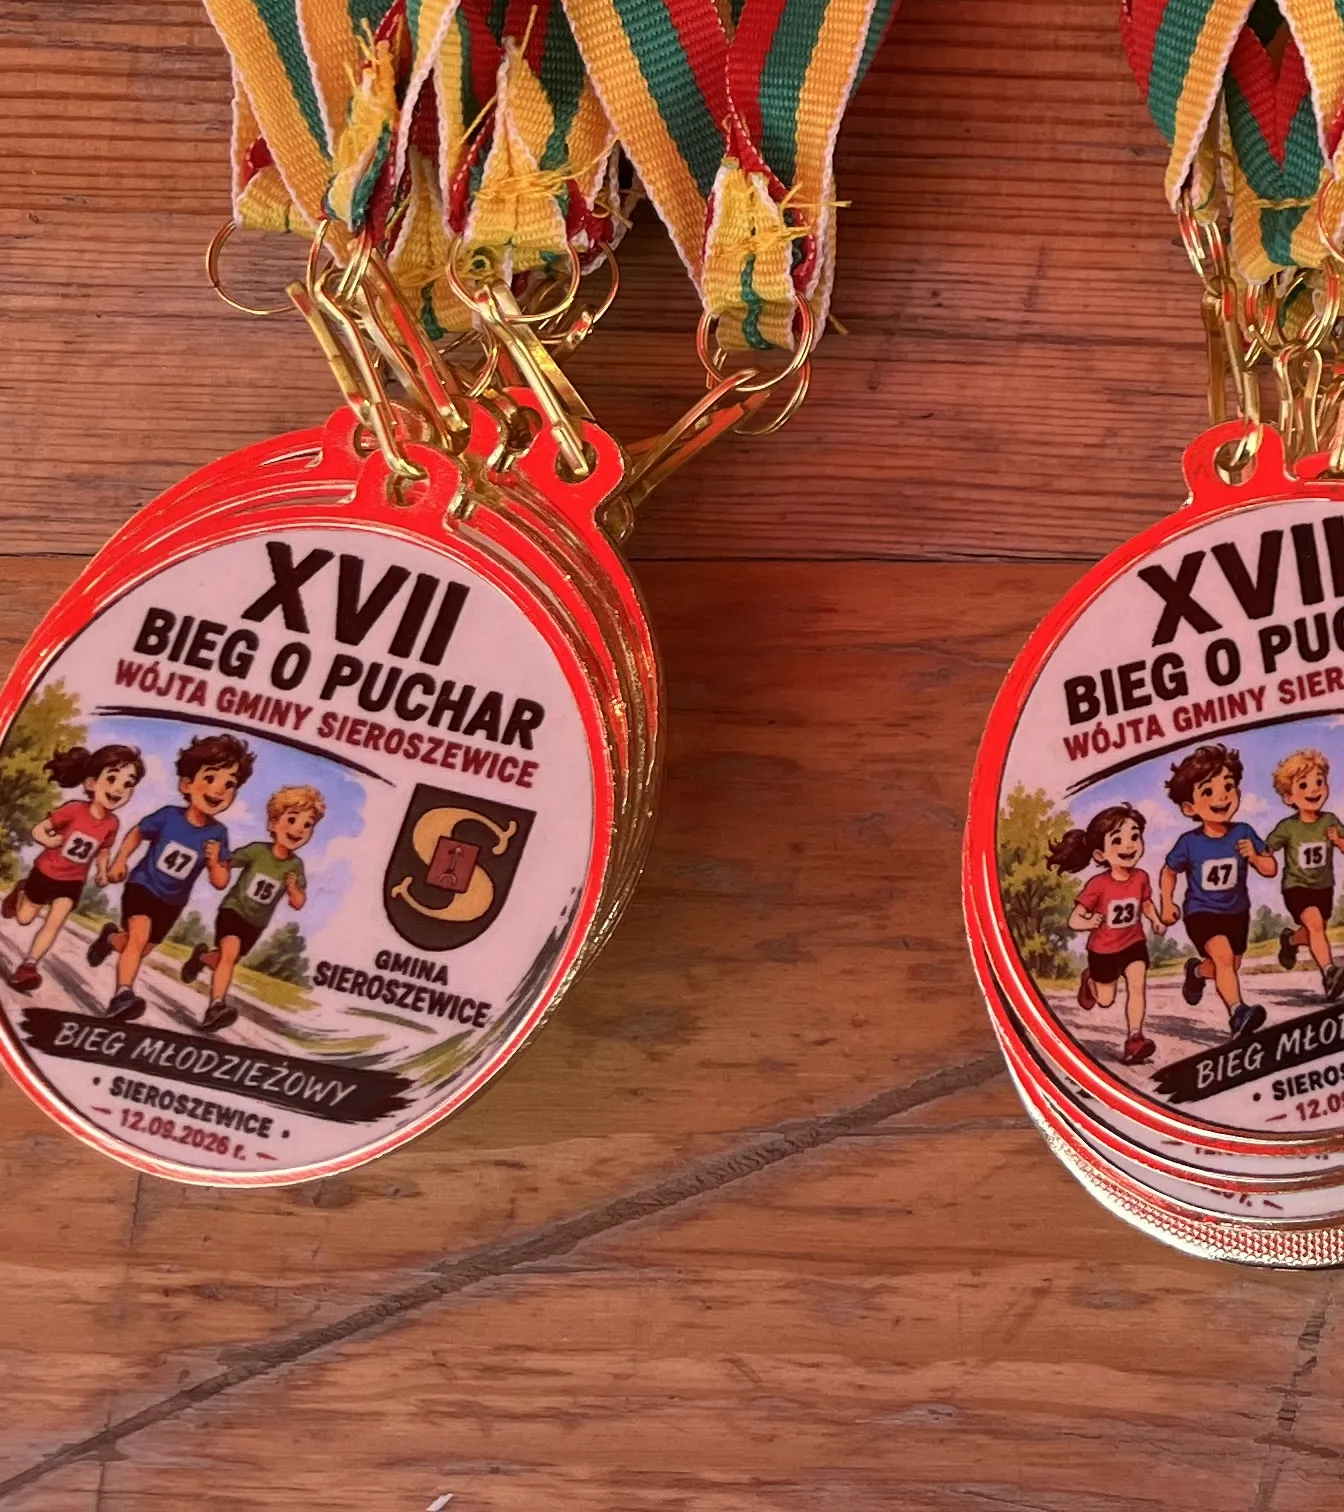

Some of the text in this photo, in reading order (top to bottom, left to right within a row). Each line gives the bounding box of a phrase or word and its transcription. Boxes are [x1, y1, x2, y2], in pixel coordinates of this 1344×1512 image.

[242, 541, 470, 666] XVII
[134, 607, 545, 750] BIEG O PUCHAR
[1063, 651, 1187, 725] BIEG
[1206, 636, 1242, 686] O
[115, 658, 540, 787] WÓJTA GMINY SIEROSZEWICE
[1063, 710, 1165, 761] WÓJTA
[1172, 688, 1266, 733] GMINY
[66, 837, 90, 859] 23
[164, 848, 188, 873] 47
[1302, 845, 1324, 865] 15
[252, 878, 274, 899] 15
[1207, 861, 1231, 887] 47
[1111, 903, 1135, 924] 23
[374, 949, 448, 986] GMINA
[312, 960, 492, 1028] SIEROSZEWICE
[54, 1022, 357, 1105] BIEG MŁODZIEŻOWY
[1196, 1046, 1264, 1088] BIEG
[109, 1075, 273, 1138] SIEROSZEWICE
[120, 1108, 228, 1154] 12.09.2026
